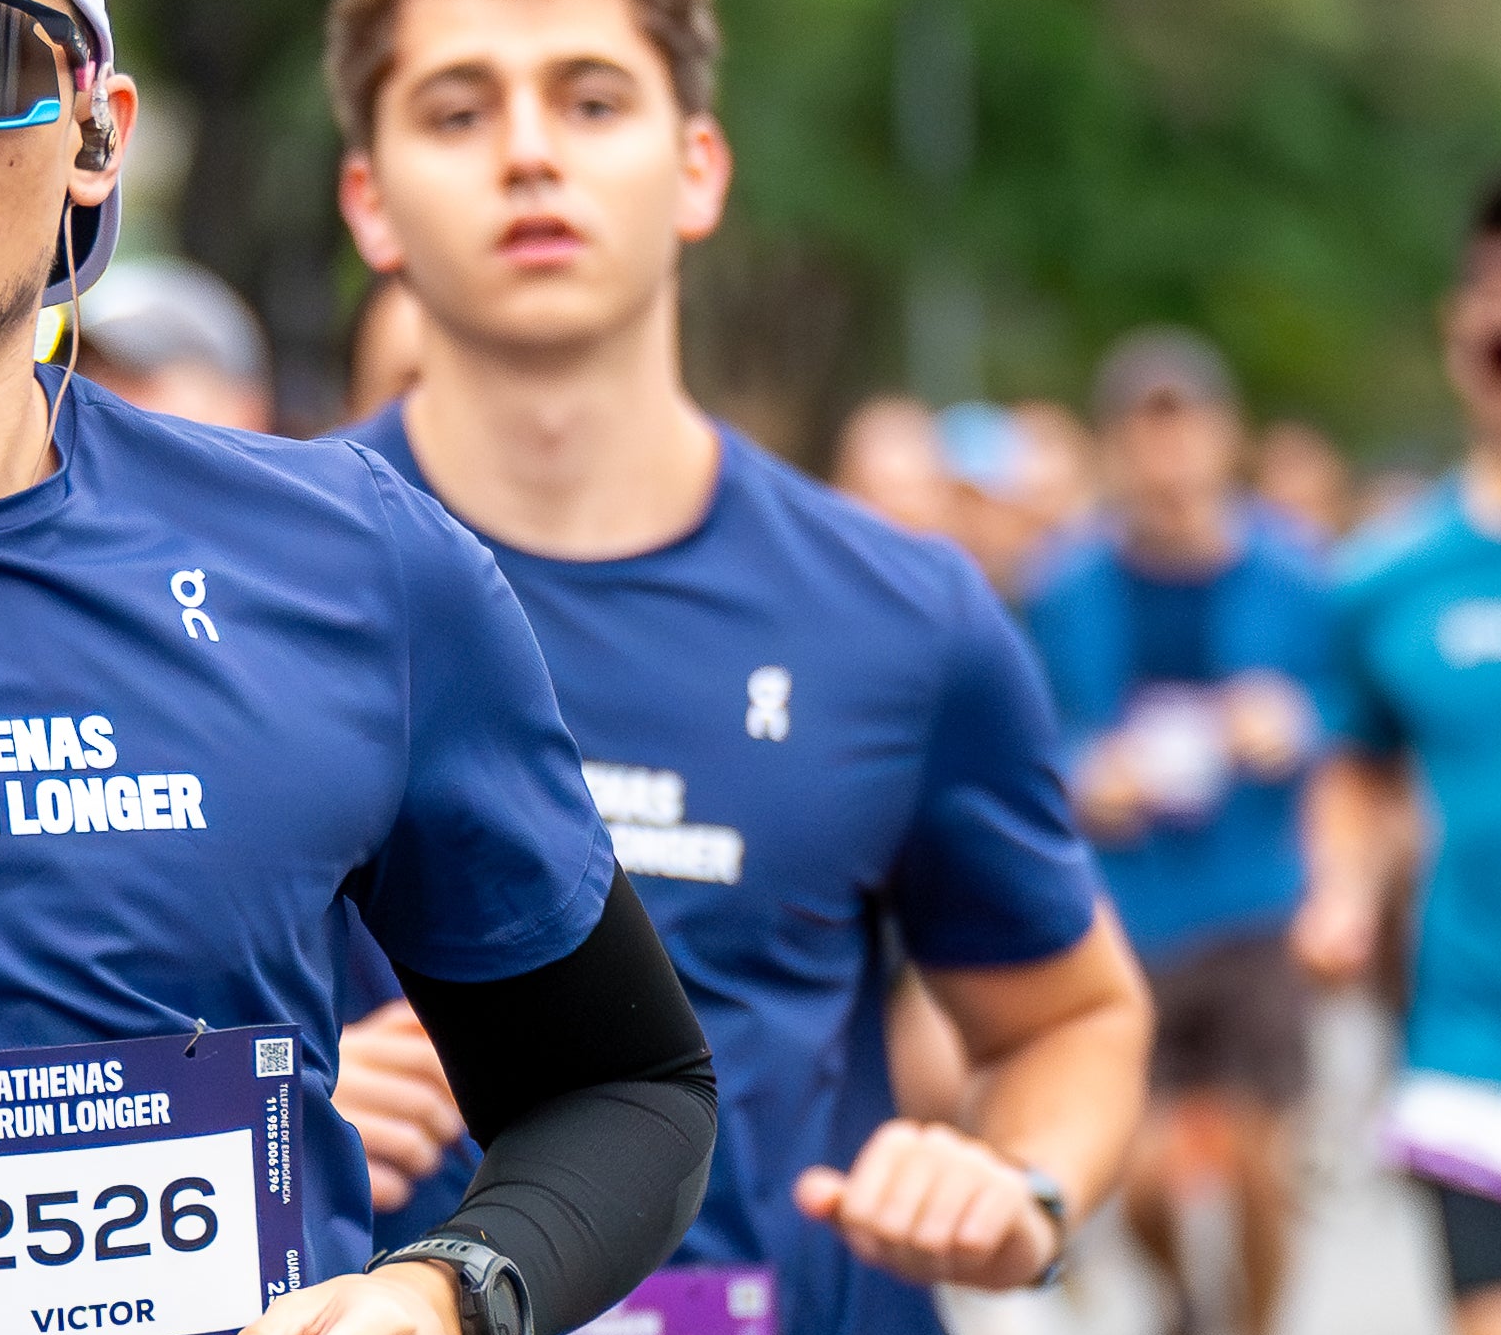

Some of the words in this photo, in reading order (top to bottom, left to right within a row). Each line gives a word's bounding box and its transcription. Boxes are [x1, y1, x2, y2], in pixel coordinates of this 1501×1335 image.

[6, 773, 208, 835] LONGER
[58, 1093, 171, 1136] LONGER
[266, 1097, 277, 1112] 11
[279, 1083, 290, 1129] TELEFONE
[281, 1130, 290, 1143] DE
[268, 1142, 279, 1166] 006
[269, 1168, 280, 1193] 296
[31, 1298, 155, 1332] VICTOR
